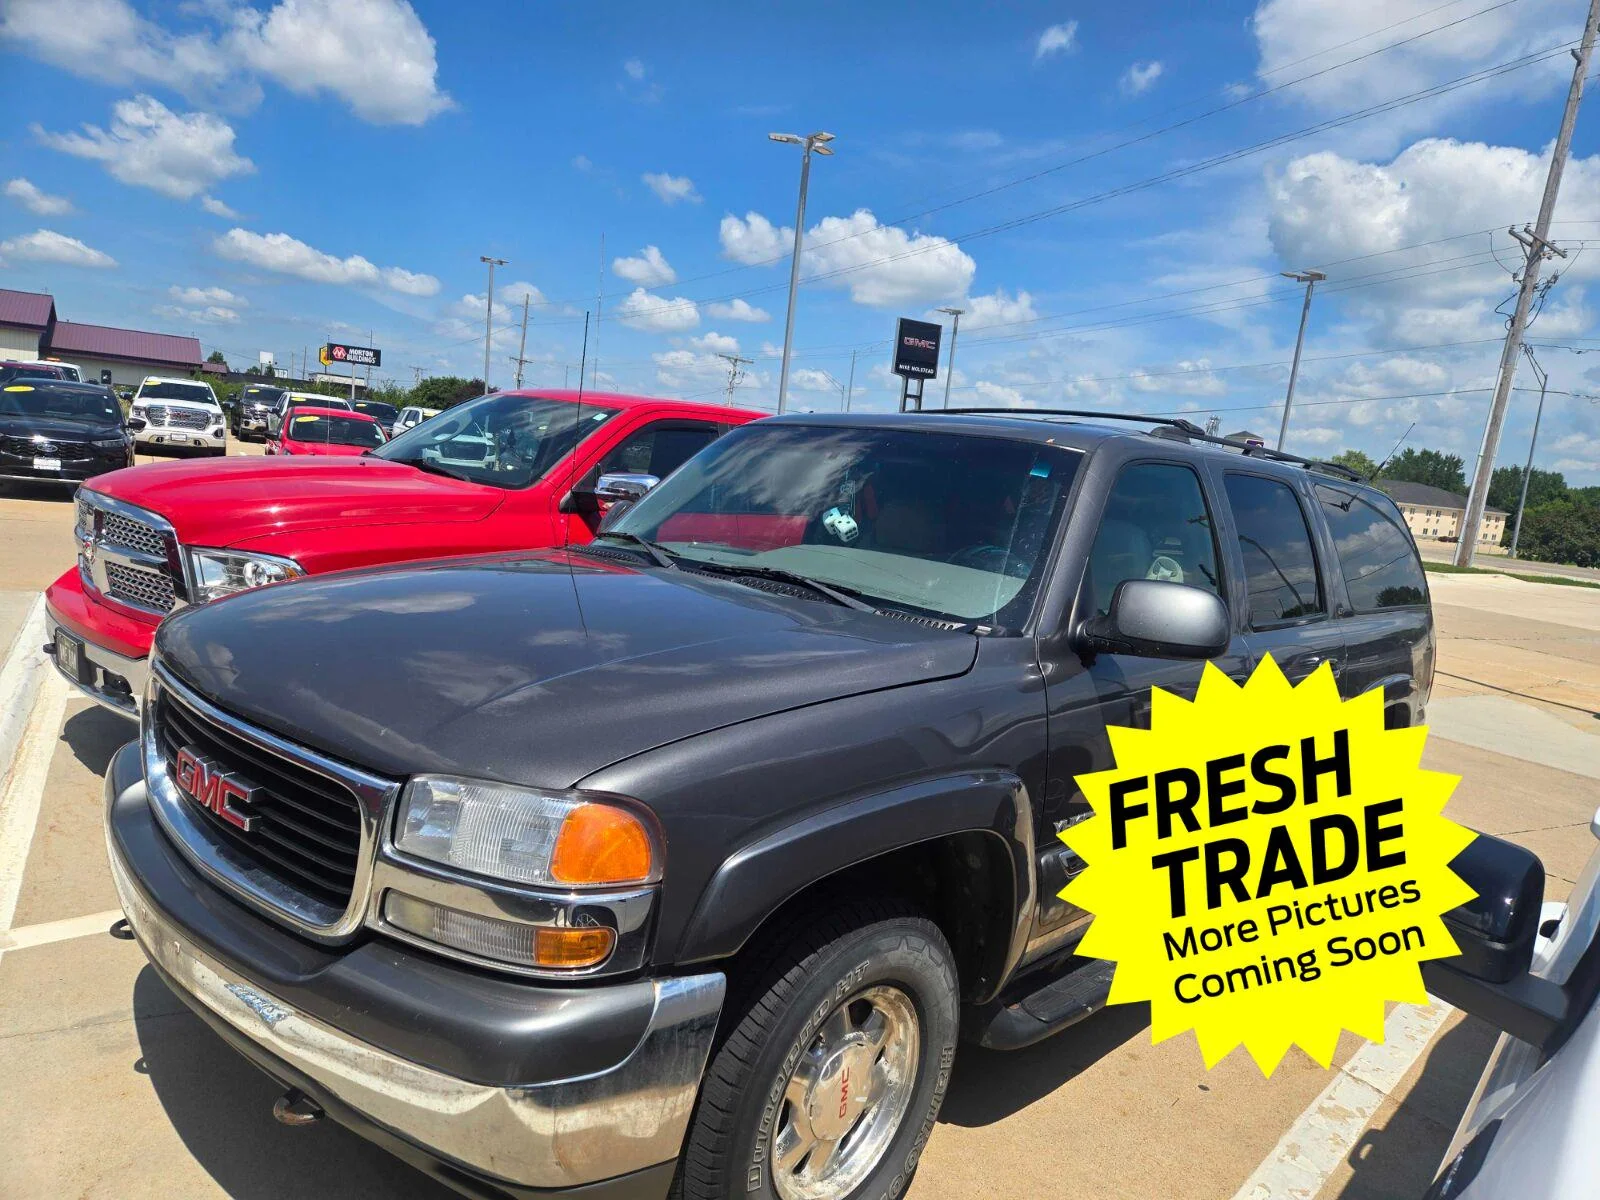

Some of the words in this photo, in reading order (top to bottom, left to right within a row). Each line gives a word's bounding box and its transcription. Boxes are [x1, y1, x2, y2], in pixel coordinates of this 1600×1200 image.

[349, 349, 373, 357] MORTON
[904, 337, 935, 349] GMC
[347, 354, 376, 363] BUILDINGS
[176, 746, 253, 832] GMC
[835, 960, 871, 1001] HT
[838, 1066, 851, 1119] GMC
